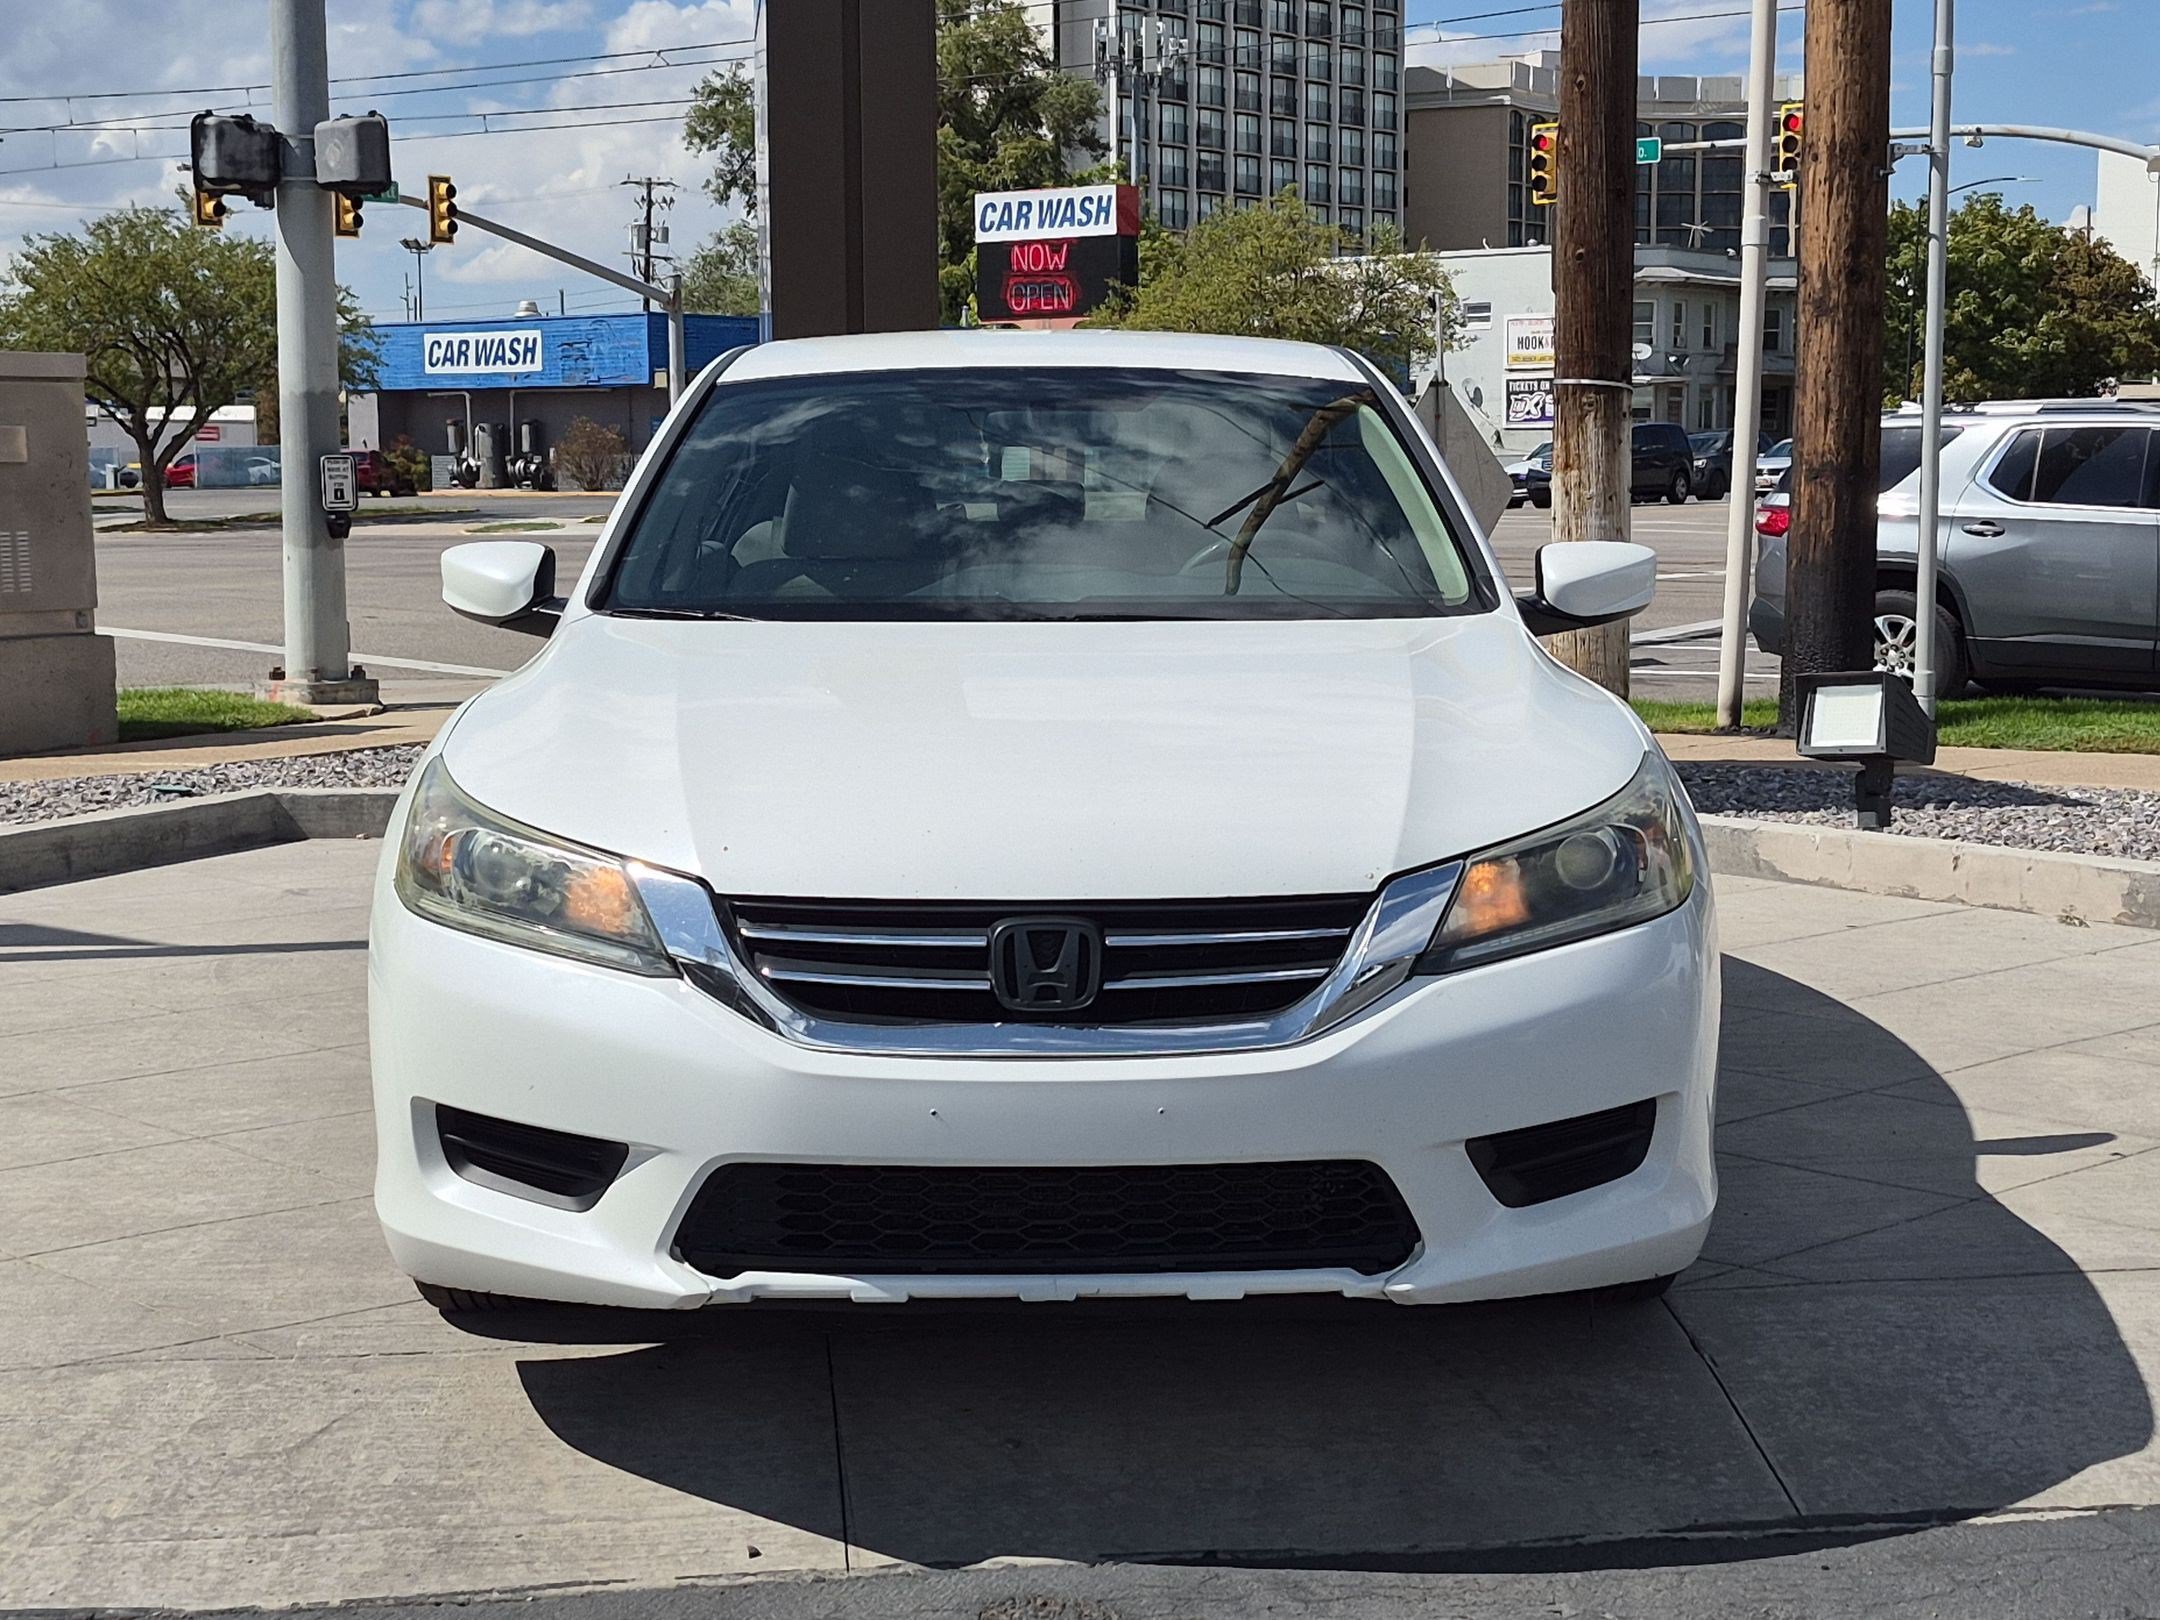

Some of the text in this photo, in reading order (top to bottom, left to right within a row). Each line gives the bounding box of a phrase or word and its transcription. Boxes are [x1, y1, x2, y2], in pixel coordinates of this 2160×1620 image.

[979, 194, 1113, 233] CAR WASH
[1011, 243, 1068, 271] NOW
[1011, 283, 1070, 312] OPEN
[428, 336, 538, 368] CAR WASH
[1517, 335, 1544, 350] HOOK
[1509, 380, 1538, 392] TICKETS
